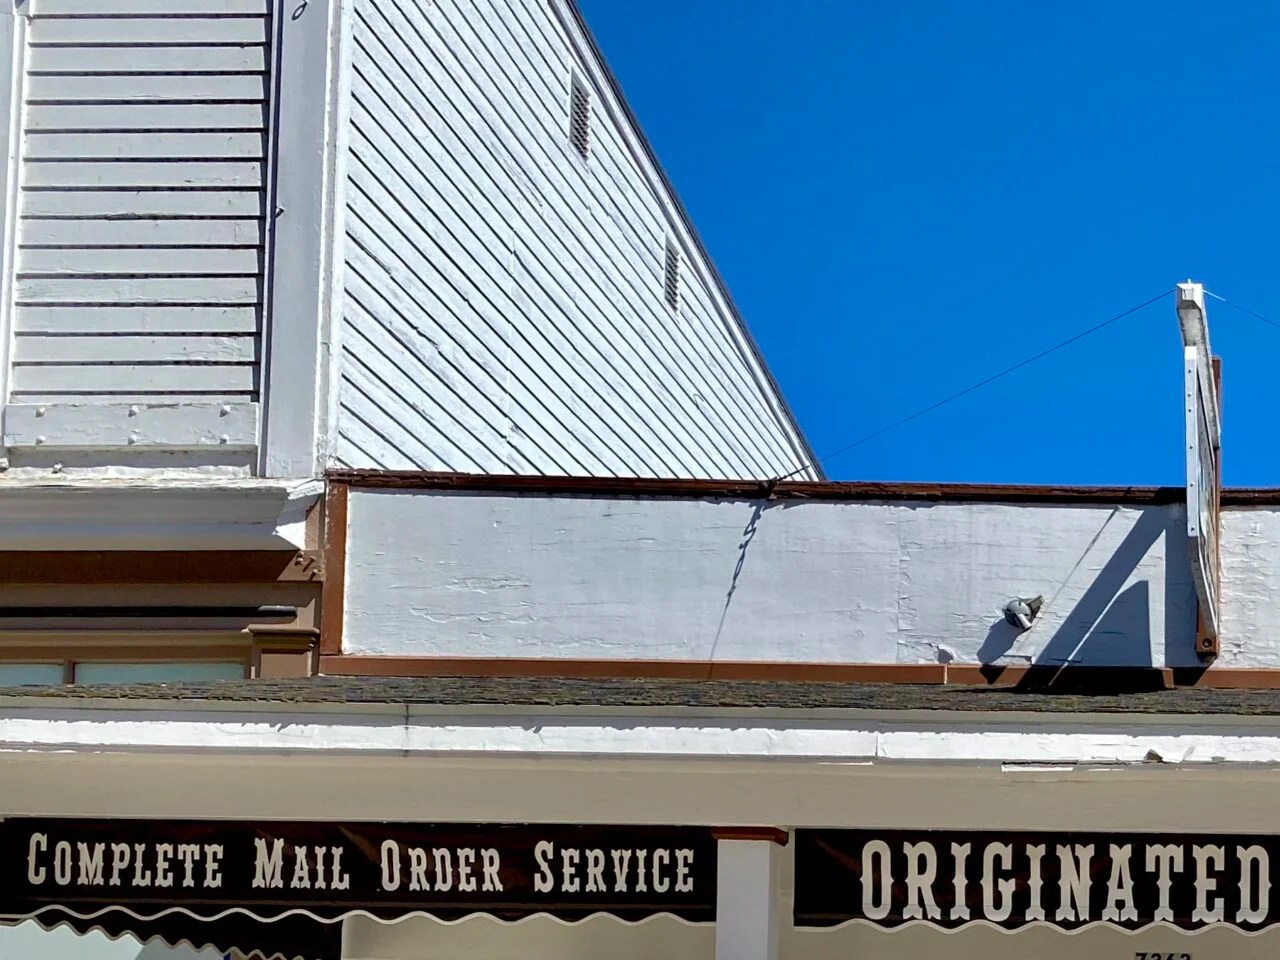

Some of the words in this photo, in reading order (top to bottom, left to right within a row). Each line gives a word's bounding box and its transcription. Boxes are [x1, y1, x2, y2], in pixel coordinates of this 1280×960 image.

[28, 831, 225, 888] COMPLETE
[252, 836, 350, 891] MAIL
[380, 839, 504, 893] ORDER
[533, 840, 696, 894] SERVICE
[860, 839, 1272, 925] ORIGINATED
